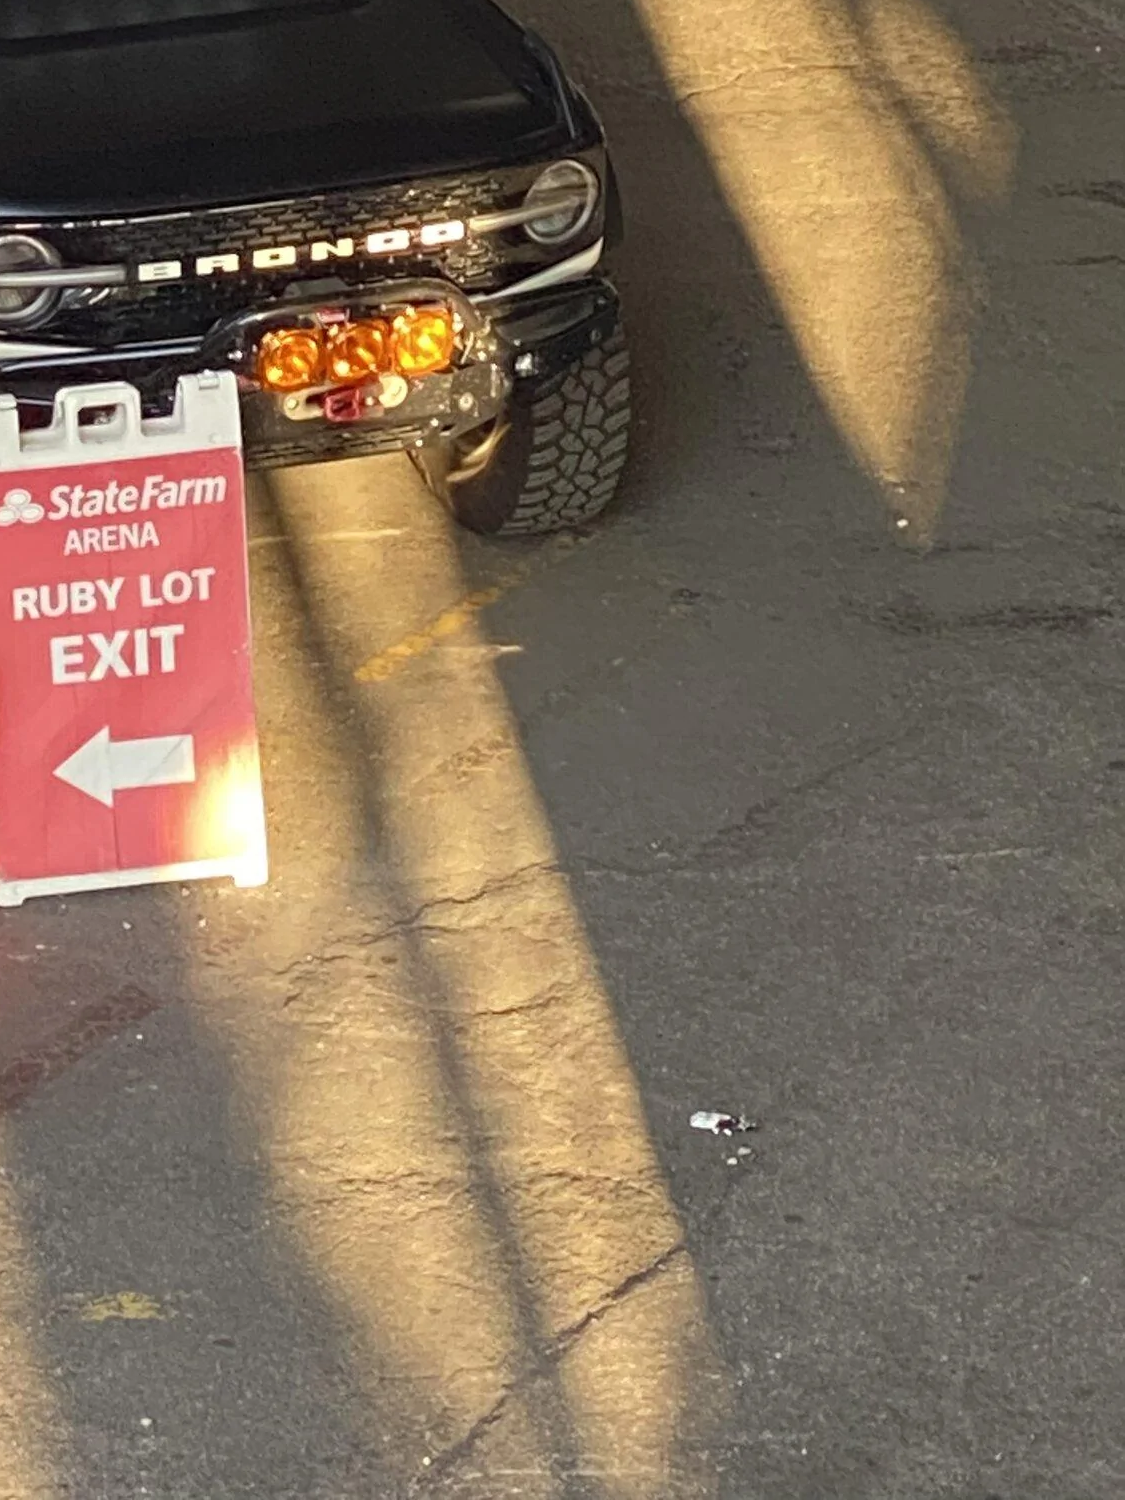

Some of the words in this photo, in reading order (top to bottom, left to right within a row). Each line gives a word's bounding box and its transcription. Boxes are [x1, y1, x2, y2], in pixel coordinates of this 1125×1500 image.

[137, 219, 465, 283] BRONCO
[63, 520, 161, 557] ARENA
[12, 576, 125, 622] RUBY
[138, 566, 216, 608] LOT
[49, 623, 185, 686] EXIT
